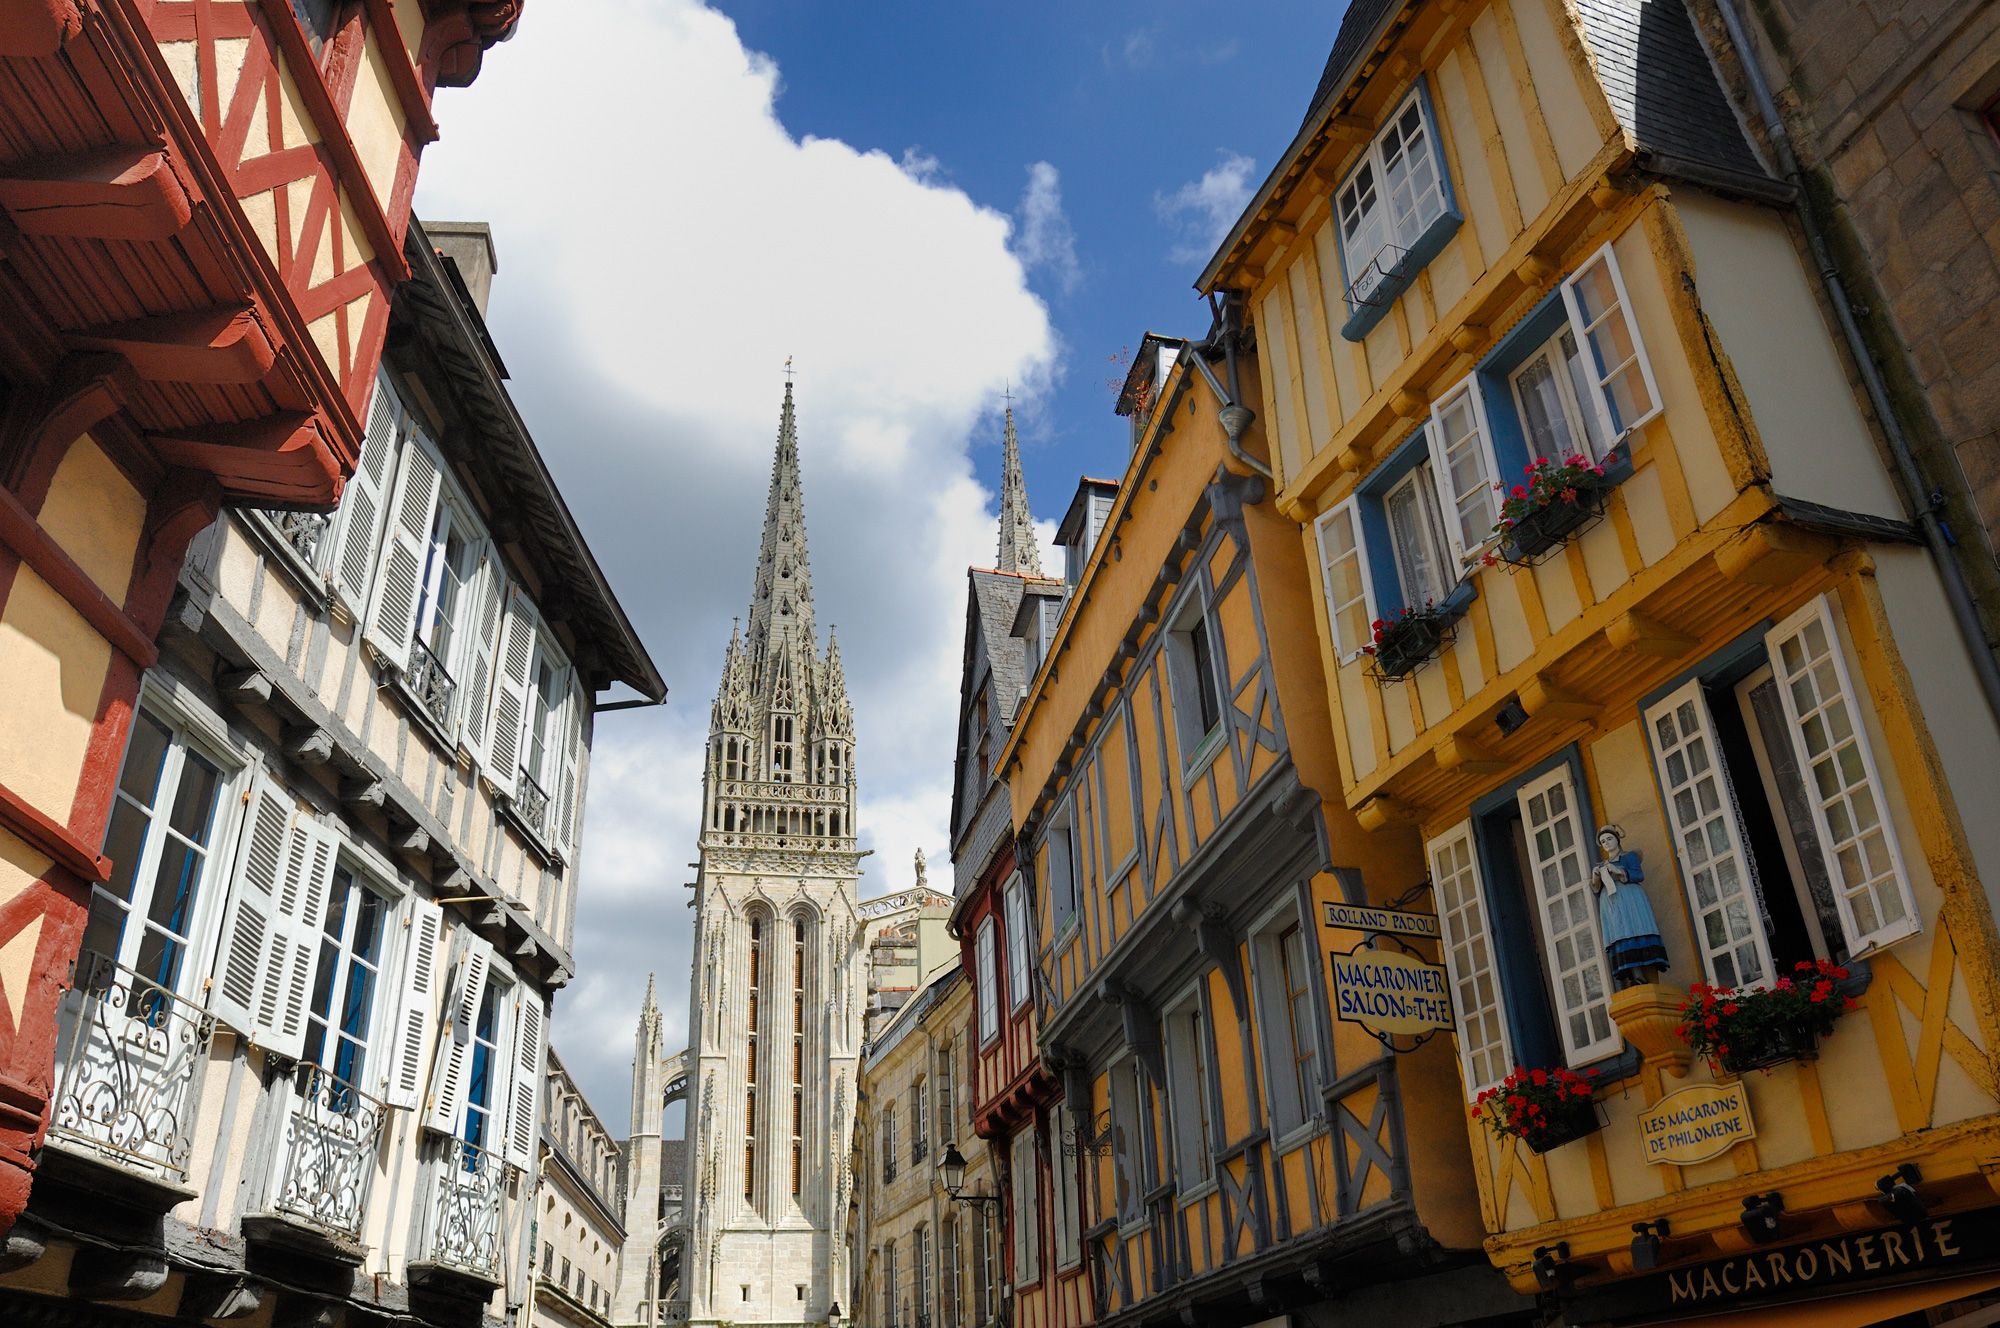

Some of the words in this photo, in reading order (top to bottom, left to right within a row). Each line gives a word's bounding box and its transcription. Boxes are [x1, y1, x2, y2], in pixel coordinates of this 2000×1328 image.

[1329, 907, 1387, 927] ROLLAND
[1392, 915, 1435, 933] PADOU
[1337, 962, 1445, 994] MACARONIER
[1341, 989, 1406, 1018] SALON
[1406, 1004, 1418, 1016] DE
[1413, 997, 1450, 1023] THE
[1644, 1116, 1666, 1134] LES
[1667, 1095, 1739, 1127] MACARONS
[1649, 1137, 1667, 1153] DE
[1667, 1116, 1743, 1148] PHILOMENE
[1668, 1220, 1961, 1304] MACARONERIE
